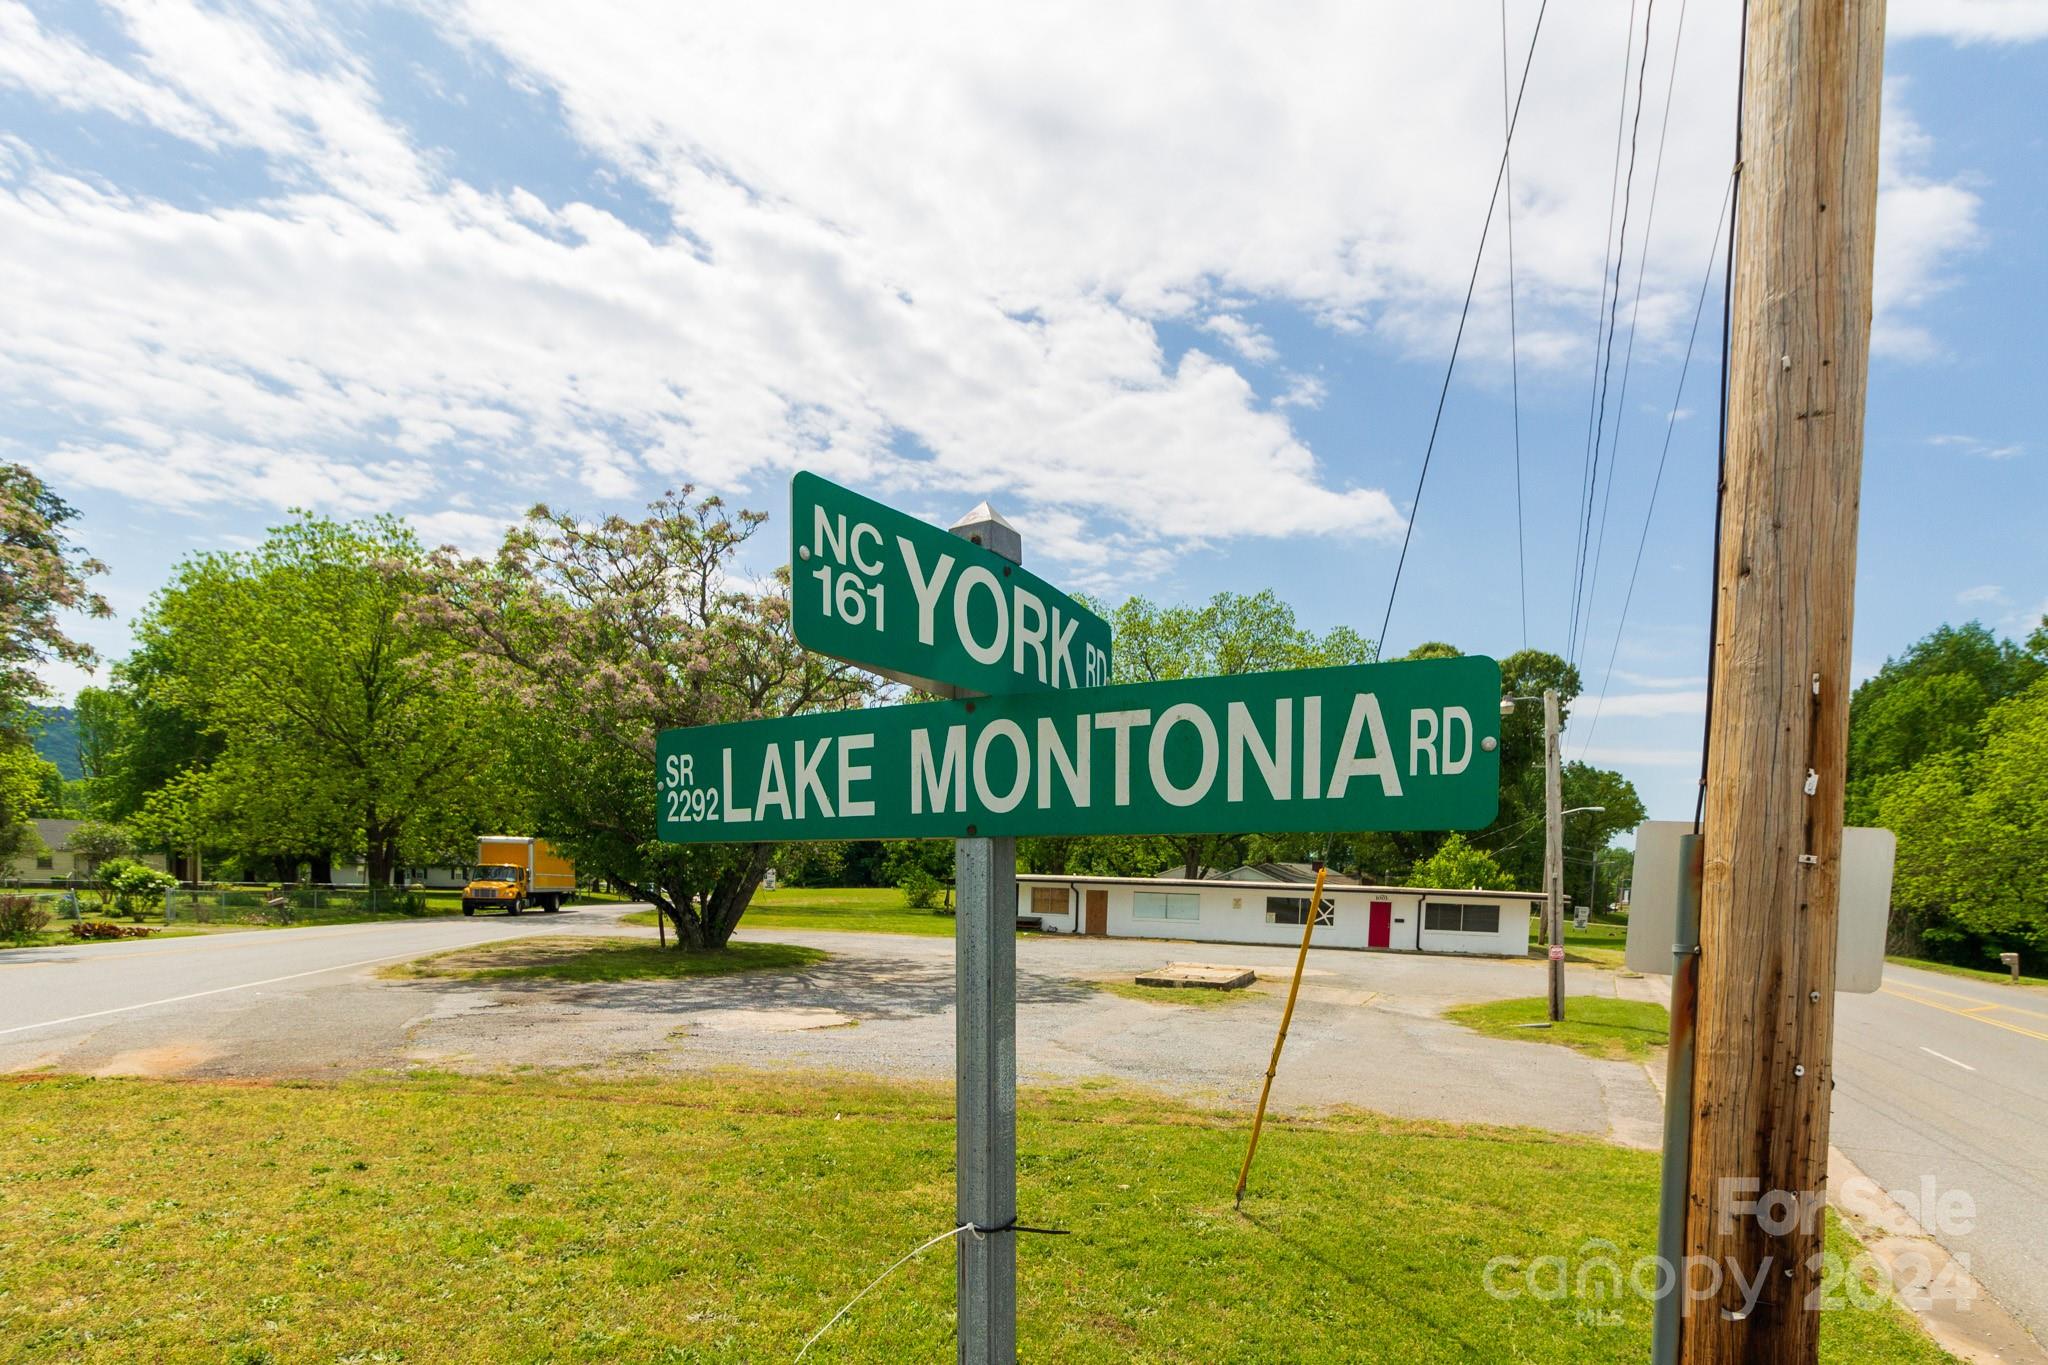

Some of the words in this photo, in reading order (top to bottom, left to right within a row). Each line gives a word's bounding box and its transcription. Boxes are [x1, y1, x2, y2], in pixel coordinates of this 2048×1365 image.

[814, 504, 884, 576] NC
[812, 565, 885, 633] 161
[896, 535, 1080, 690] YORK
[1086, 641, 1107, 688] RD
[666, 754, 694, 788] SR
[722, 733, 876, 823] LAKE
[910, 691, 1404, 815] MONTONIA
[1409, 705, 1474, 777] RD
[667, 787, 719, 823] 2292
